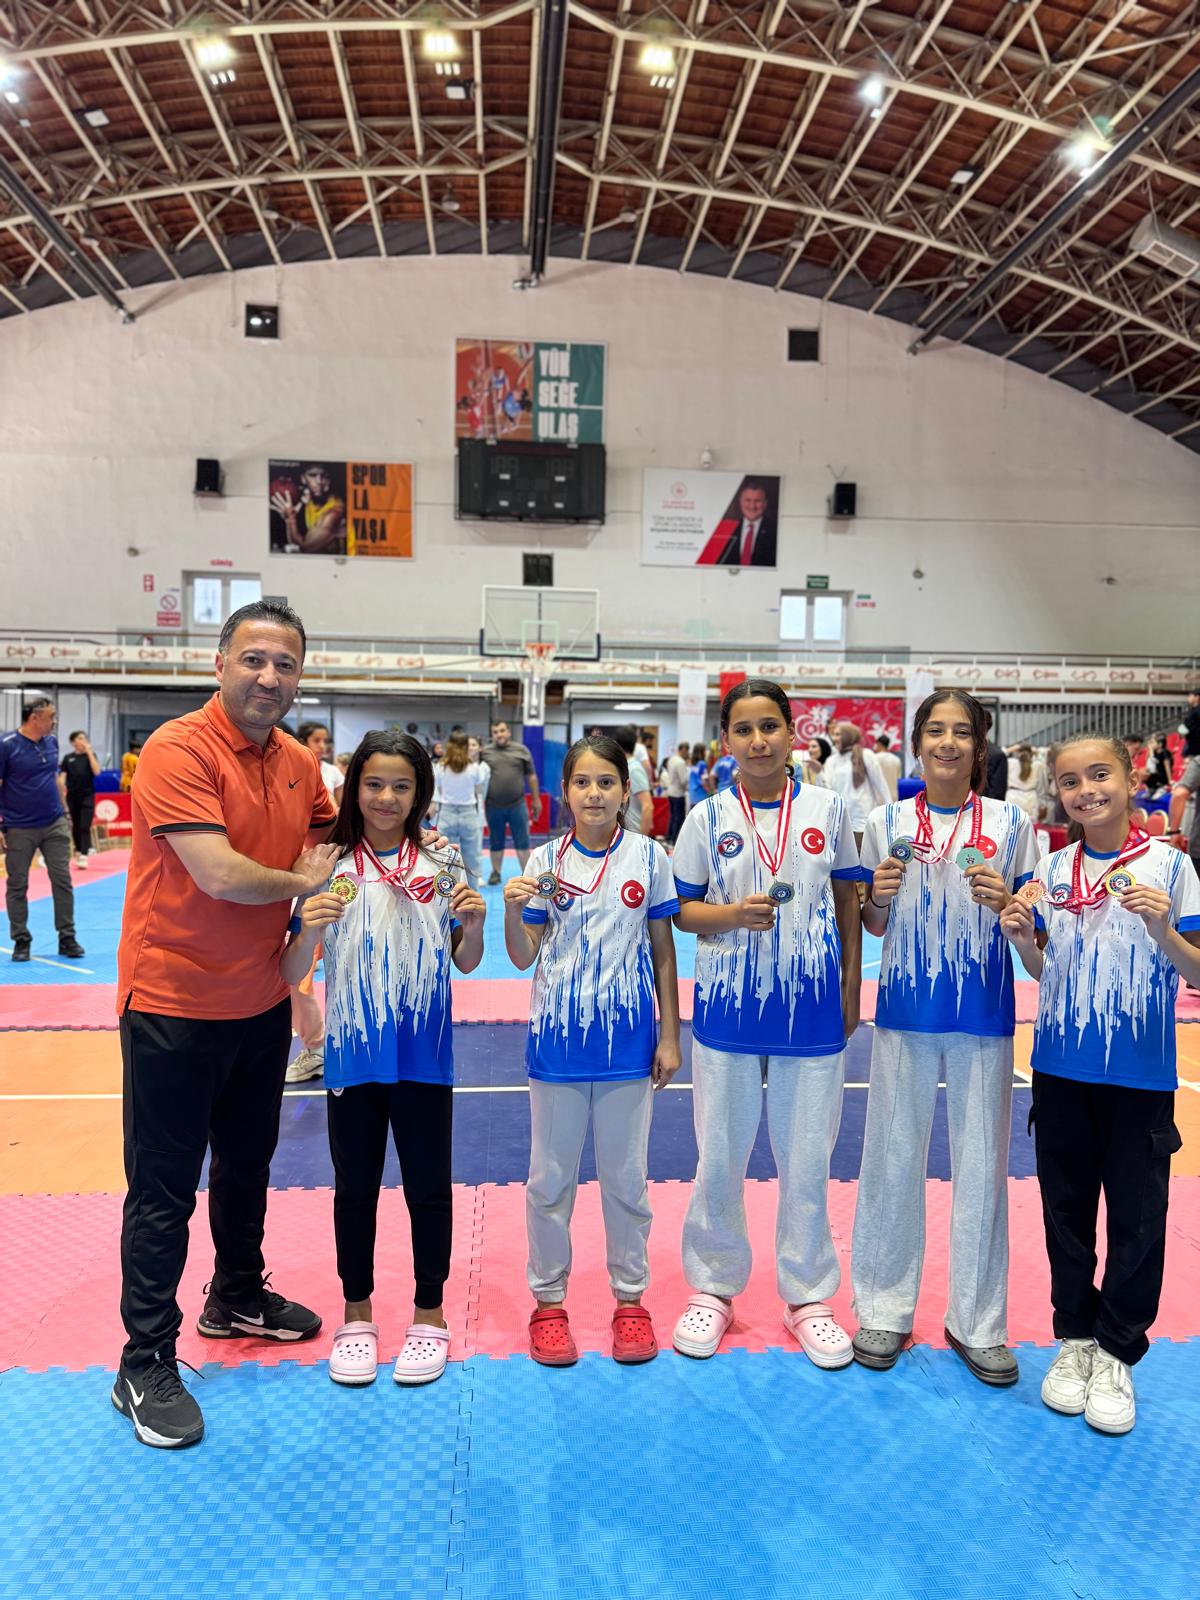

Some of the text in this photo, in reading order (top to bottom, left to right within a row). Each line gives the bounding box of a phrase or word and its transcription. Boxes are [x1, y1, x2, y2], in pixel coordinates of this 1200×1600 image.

[352, 463, 387, 486] SPOR
[353, 489, 369, 511] LA
[353, 518, 387, 543] YAŞA
